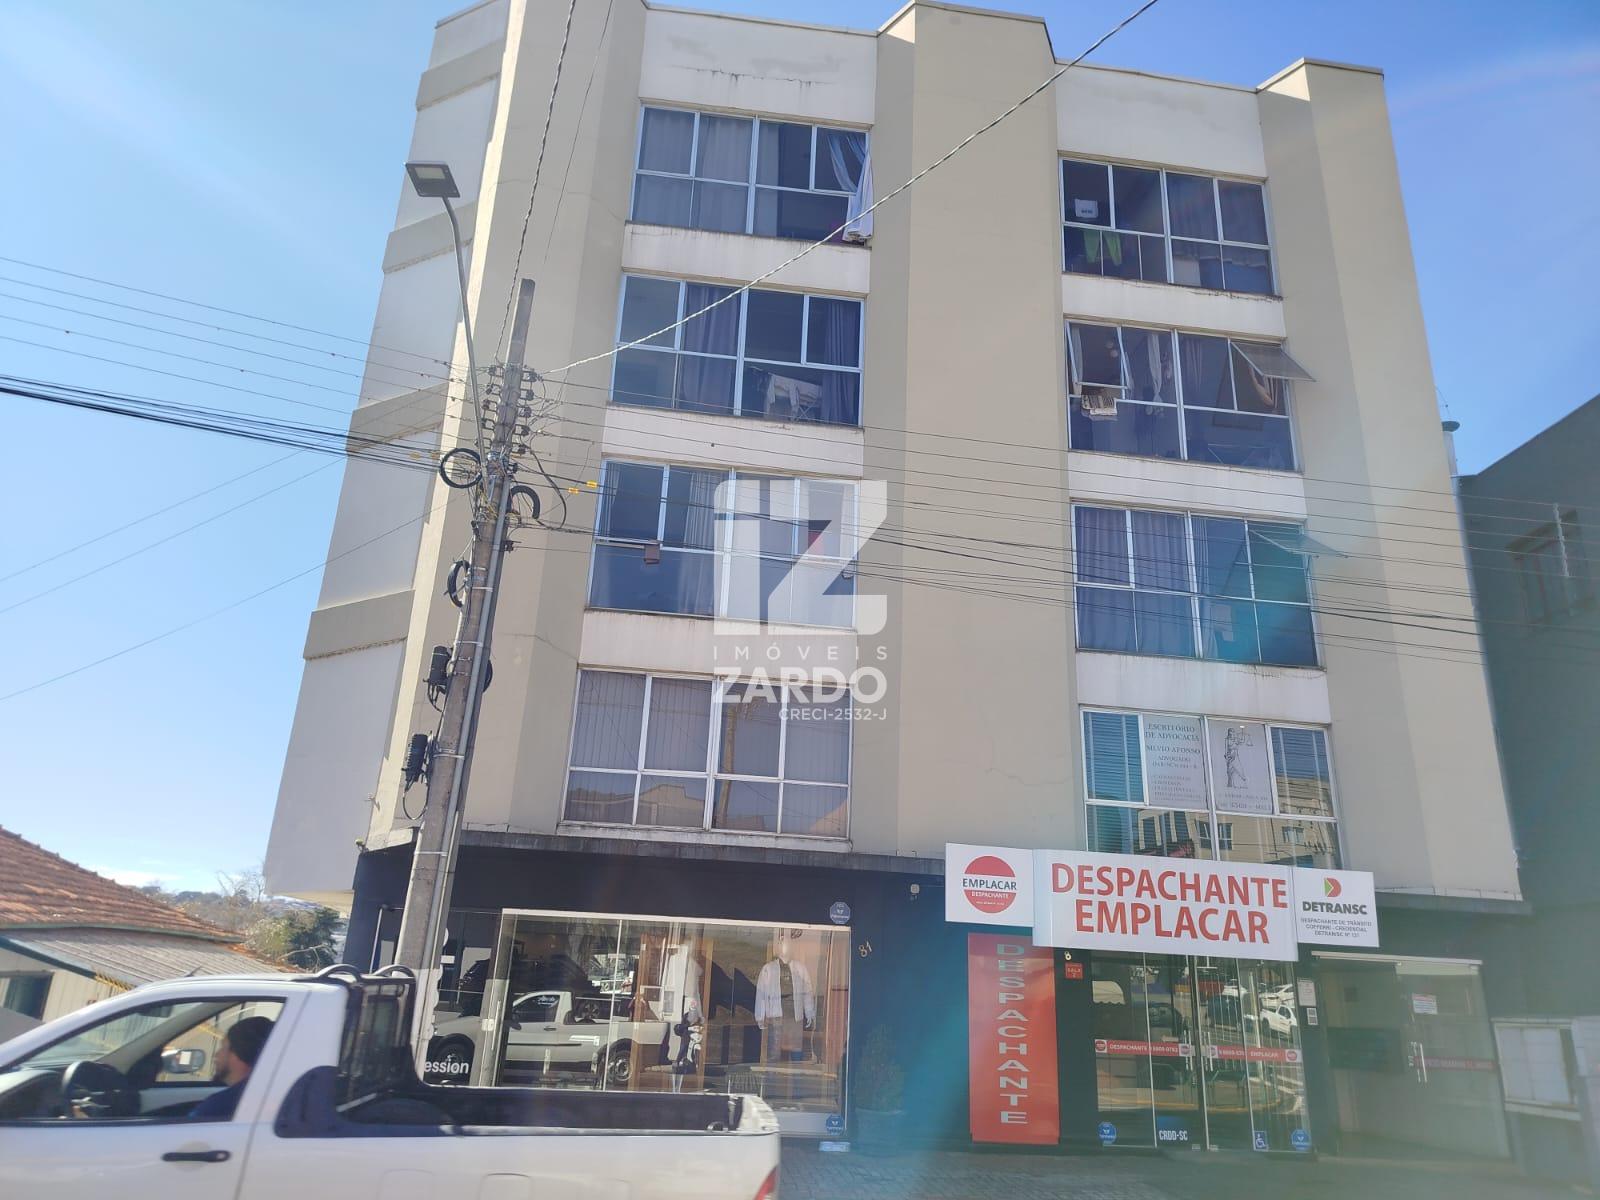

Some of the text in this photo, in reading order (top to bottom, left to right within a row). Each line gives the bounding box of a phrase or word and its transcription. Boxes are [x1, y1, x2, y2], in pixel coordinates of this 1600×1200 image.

[962, 878, 1017, 890] EMPLACAR
[1052, 863, 1288, 909] DESPACHANTE
[1075, 899, 1270, 944] EMPLACAR
[1302, 901, 1368, 915] DETRANSC
[996, 944, 1031, 1125] DESPACHANTE
[424, 1059, 470, 1074] ession
